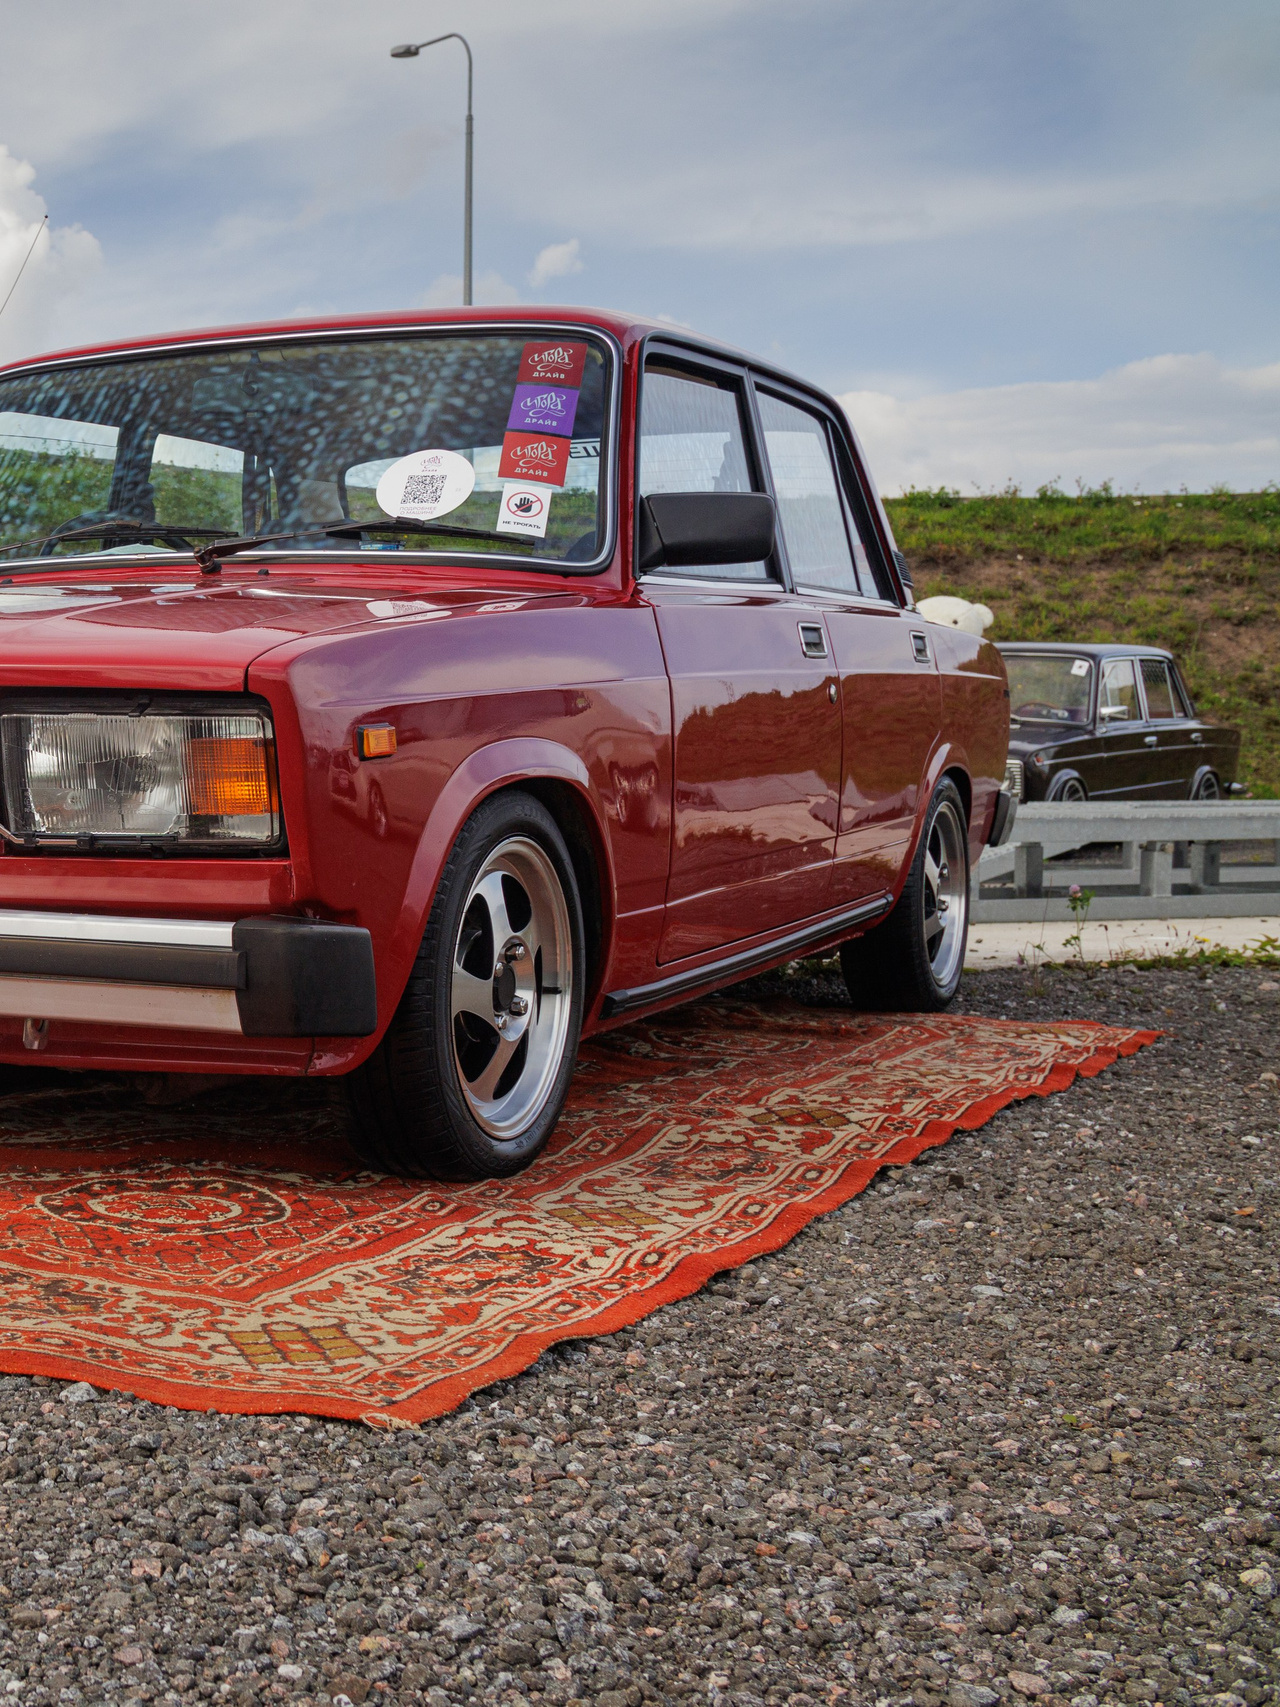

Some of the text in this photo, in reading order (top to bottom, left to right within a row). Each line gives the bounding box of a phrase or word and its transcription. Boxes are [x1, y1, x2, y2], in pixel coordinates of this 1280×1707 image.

[532, 371, 565, 379] ДРАЙВ
[524, 417, 557, 426] ДРАЙВ
[514, 467, 548, 477] ДРАЙВ
[513, 521, 541, 529] ТРОГАТЬ
